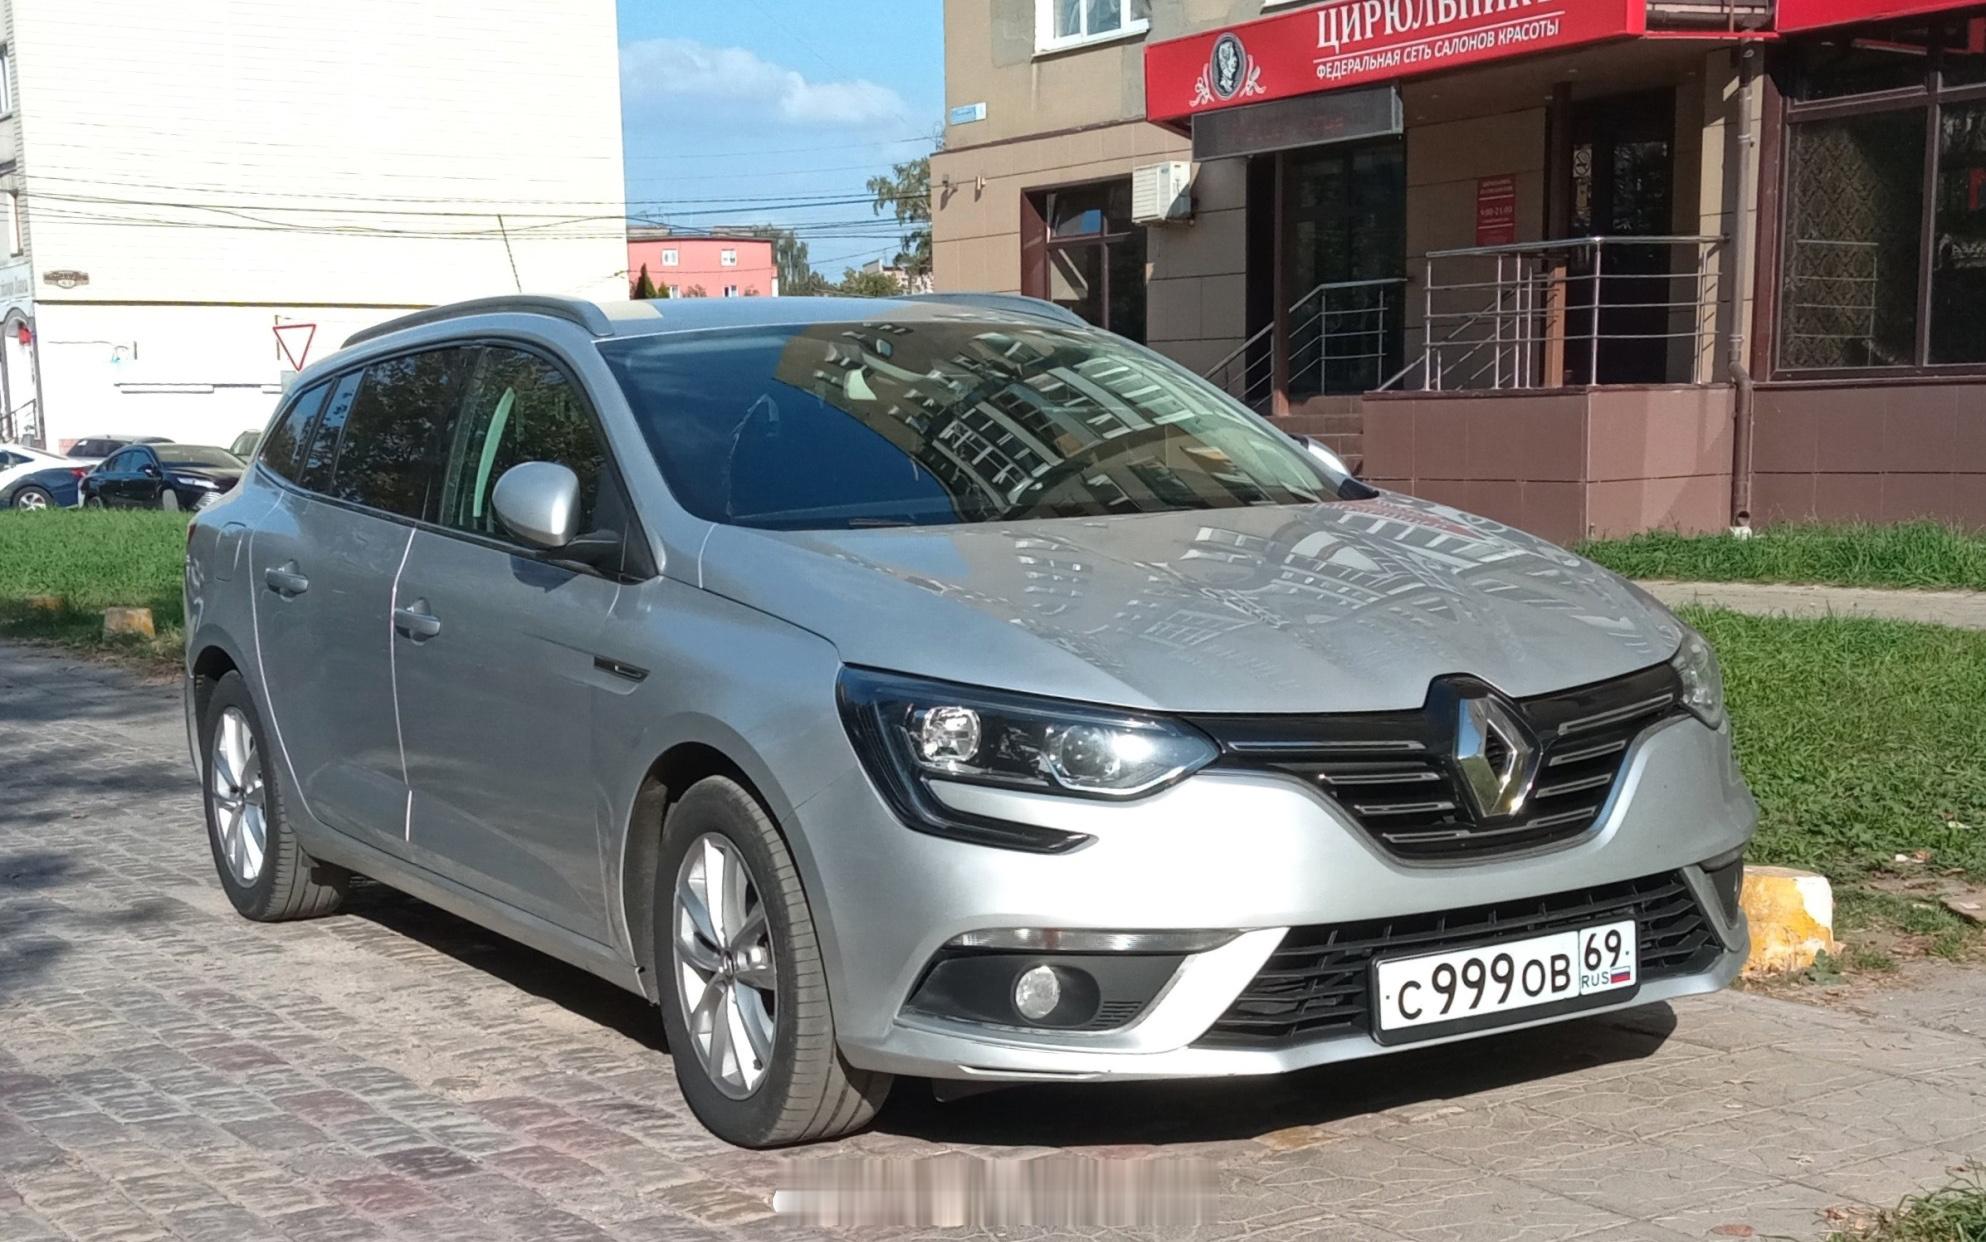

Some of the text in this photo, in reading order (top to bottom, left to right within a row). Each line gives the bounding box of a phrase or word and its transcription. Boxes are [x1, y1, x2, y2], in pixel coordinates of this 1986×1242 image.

[1316, 18, 1559, 80] ФЕДЕРАЛЬНАЯ СЕТЬ САЛОНОВ КРАСОТЫ
[1317, 0, 1552, 53] ЦИРЮЛЬ
[1583, 929, 1622, 971] 69
[1581, 972, 1610, 988] RUS
